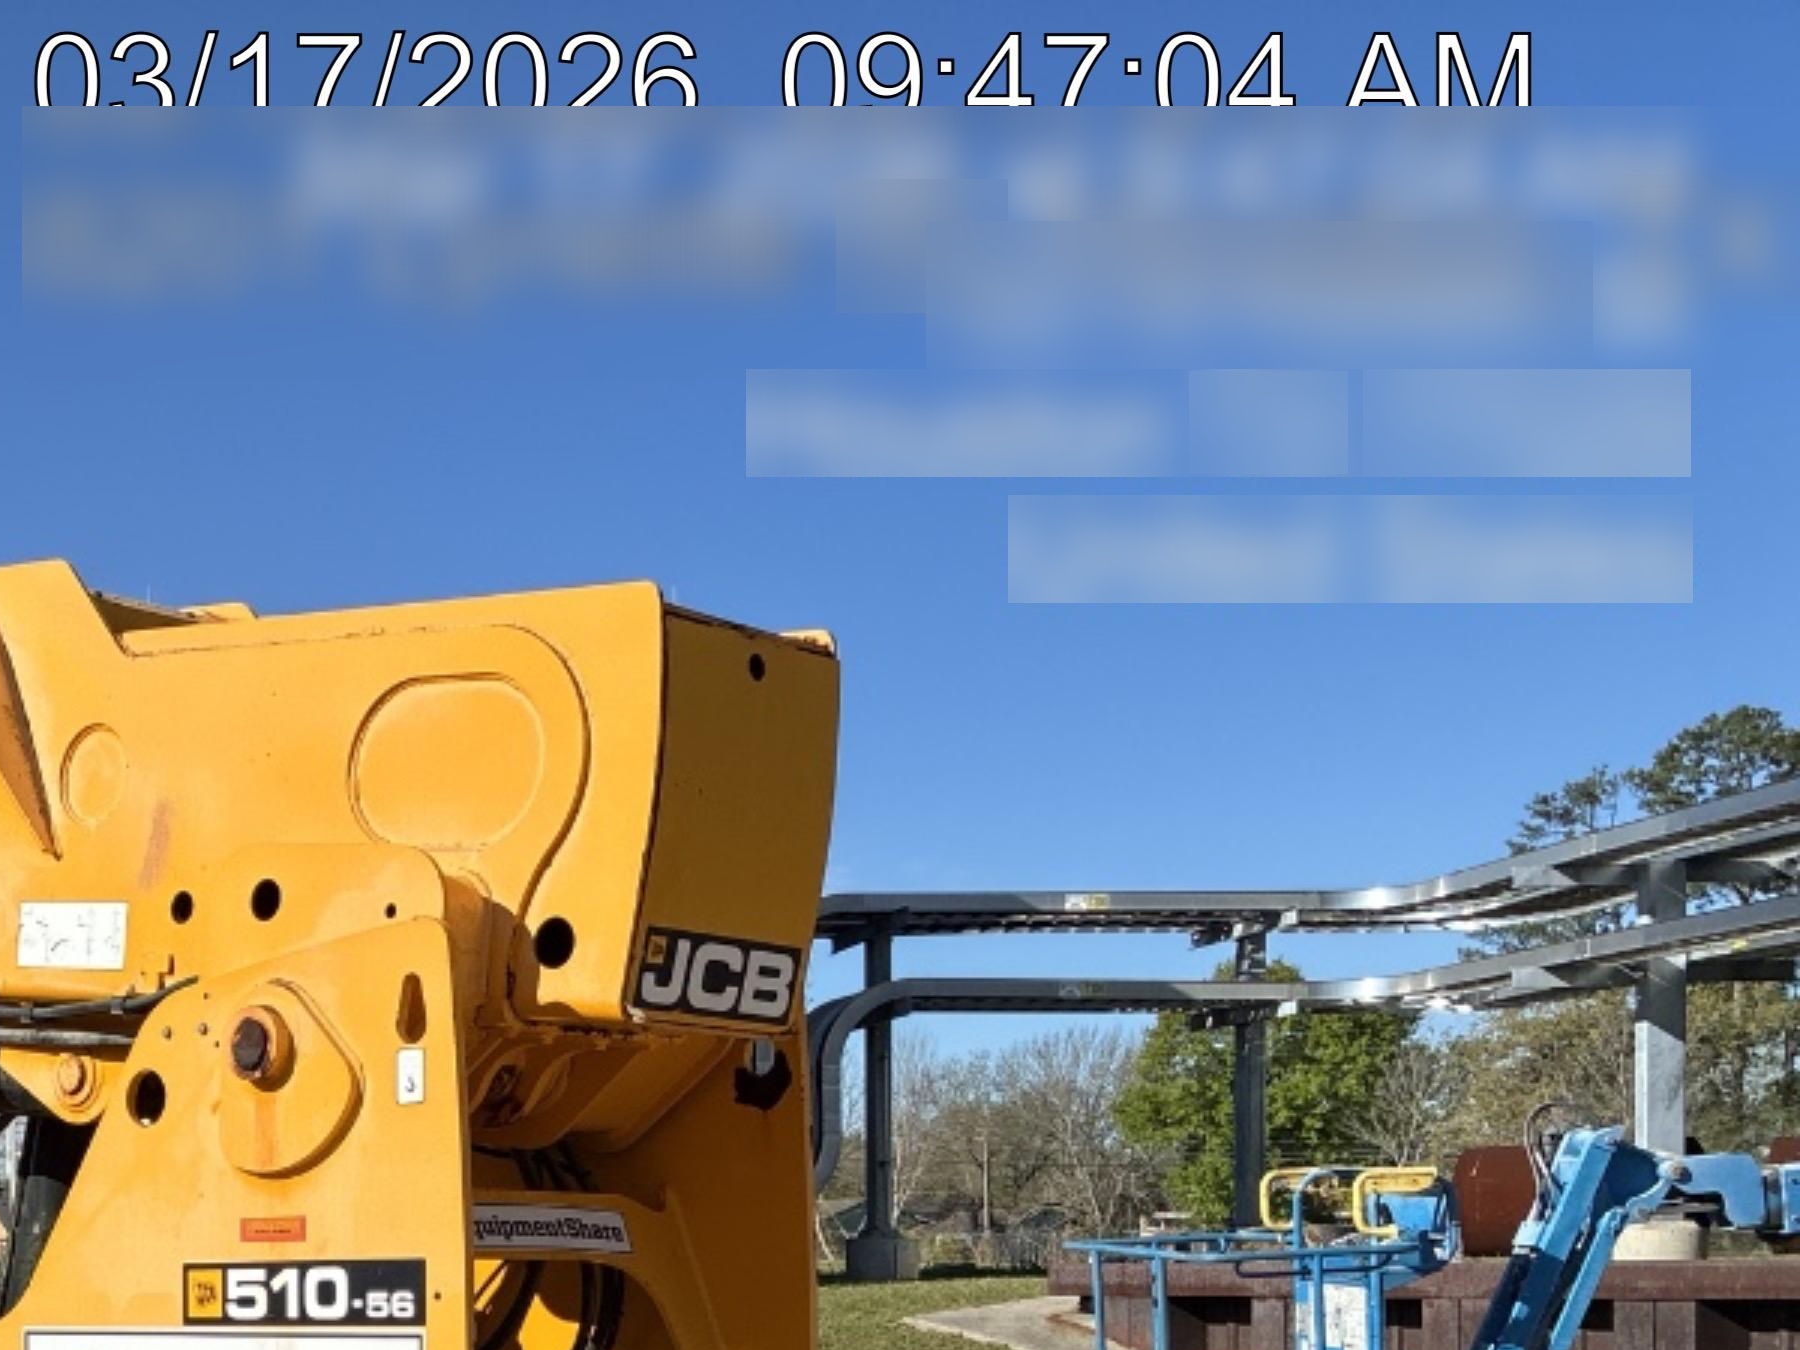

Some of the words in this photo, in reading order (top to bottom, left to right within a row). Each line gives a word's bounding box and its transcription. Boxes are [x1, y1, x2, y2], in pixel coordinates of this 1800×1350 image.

[641, 938, 795, 1018] JCB
[473, 1215, 625, 1242] quipmentShare
[224, 1265, 416, 1321] 510-56
